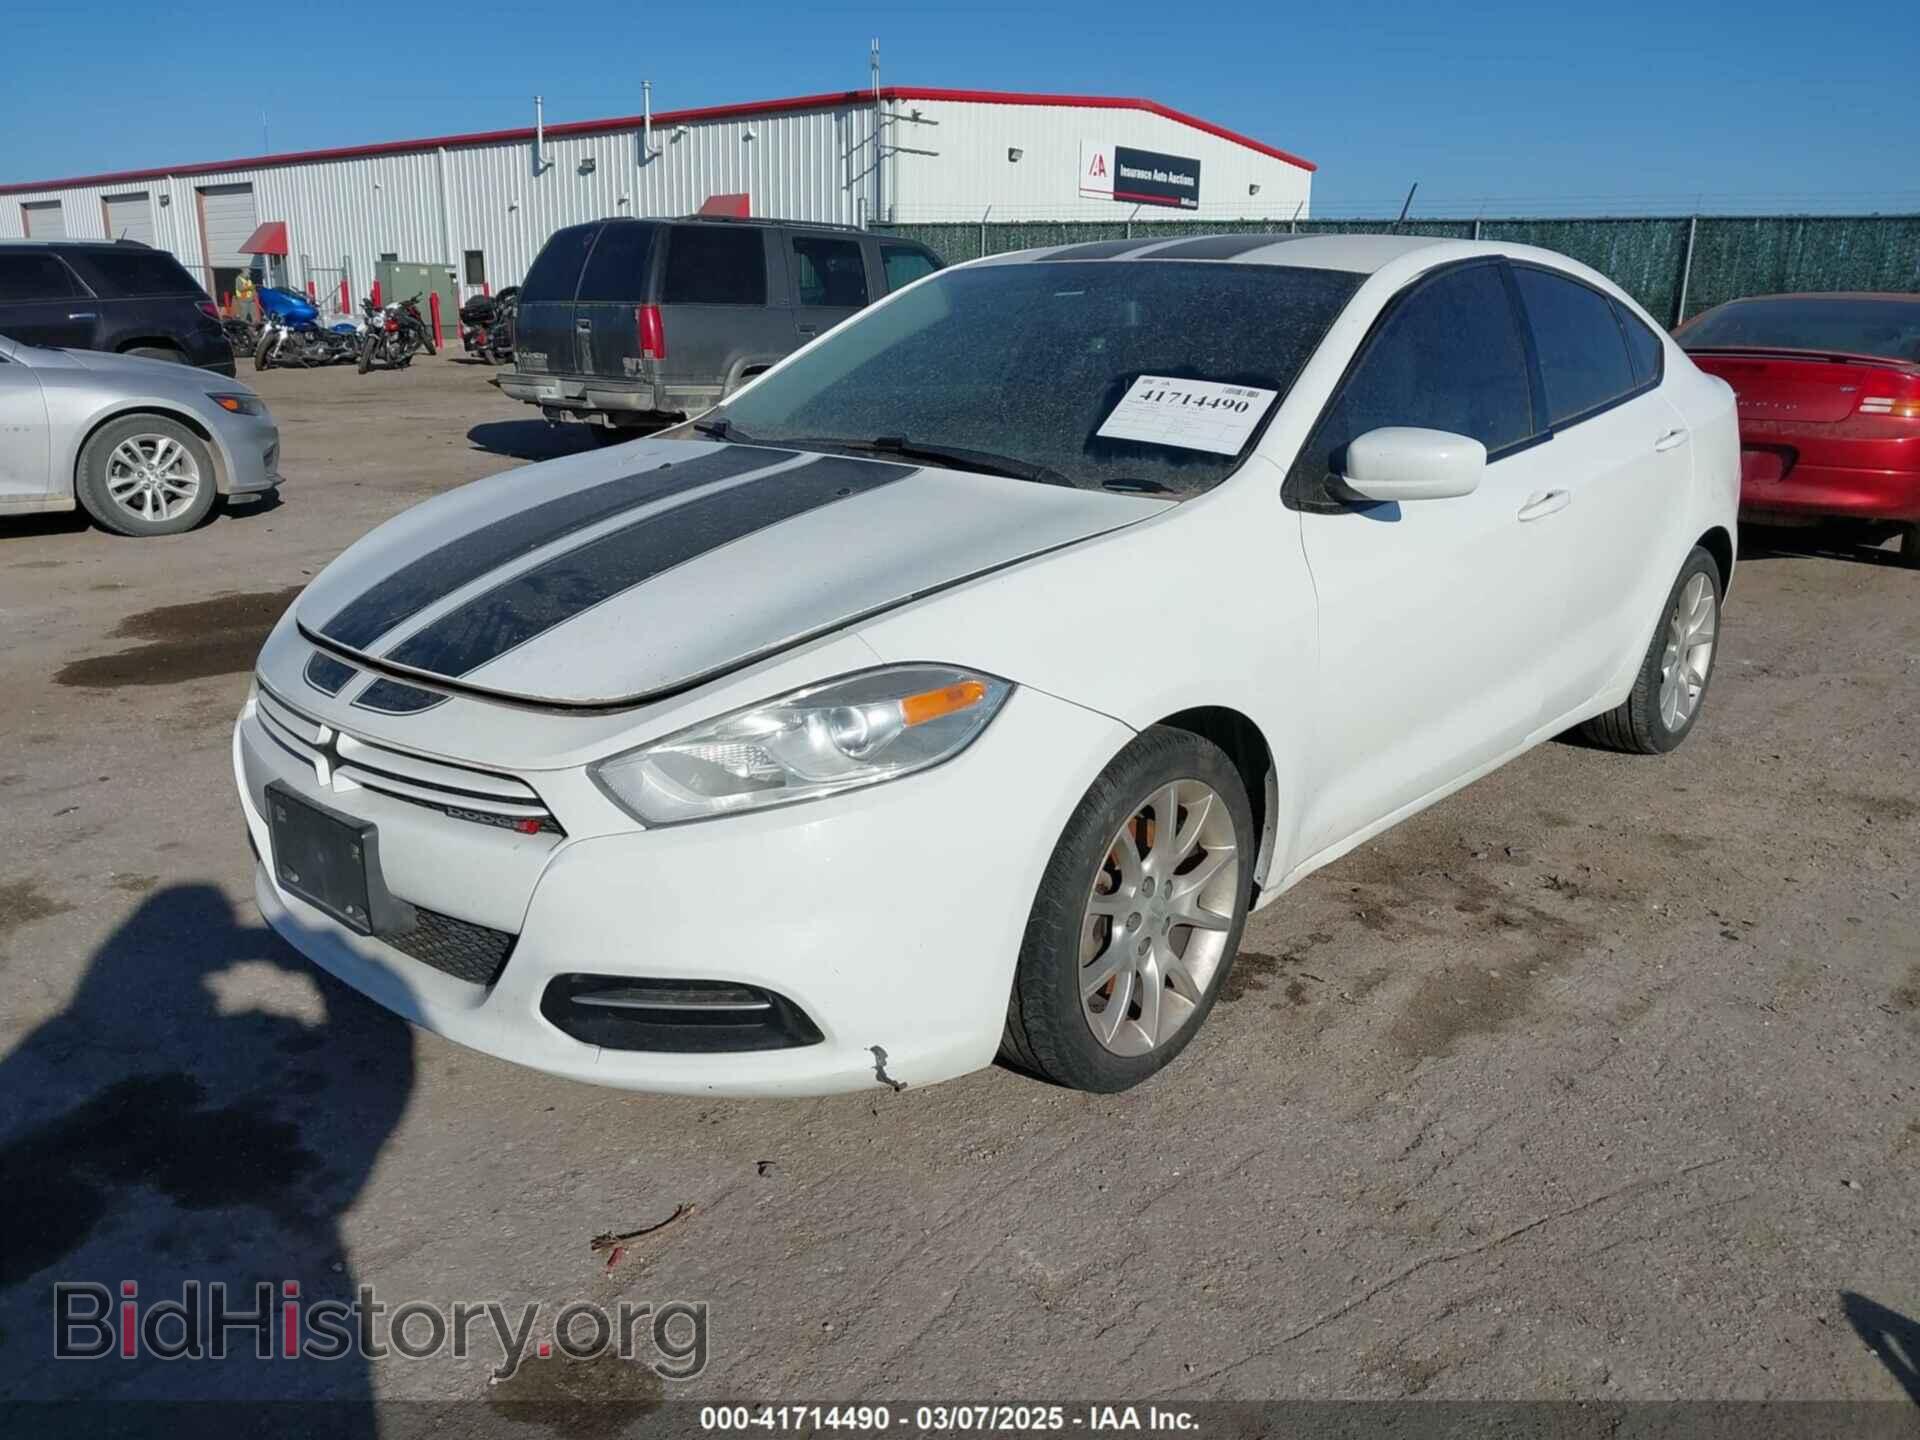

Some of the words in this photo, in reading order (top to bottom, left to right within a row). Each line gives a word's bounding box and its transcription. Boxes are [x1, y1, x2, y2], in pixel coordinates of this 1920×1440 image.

[1120, 163, 1152, 180] Insurance
[1153, 168, 1167, 183] Auto
[1168, 171, 1195, 187] Auctions
[1139, 390, 1250, 413] 41714490
